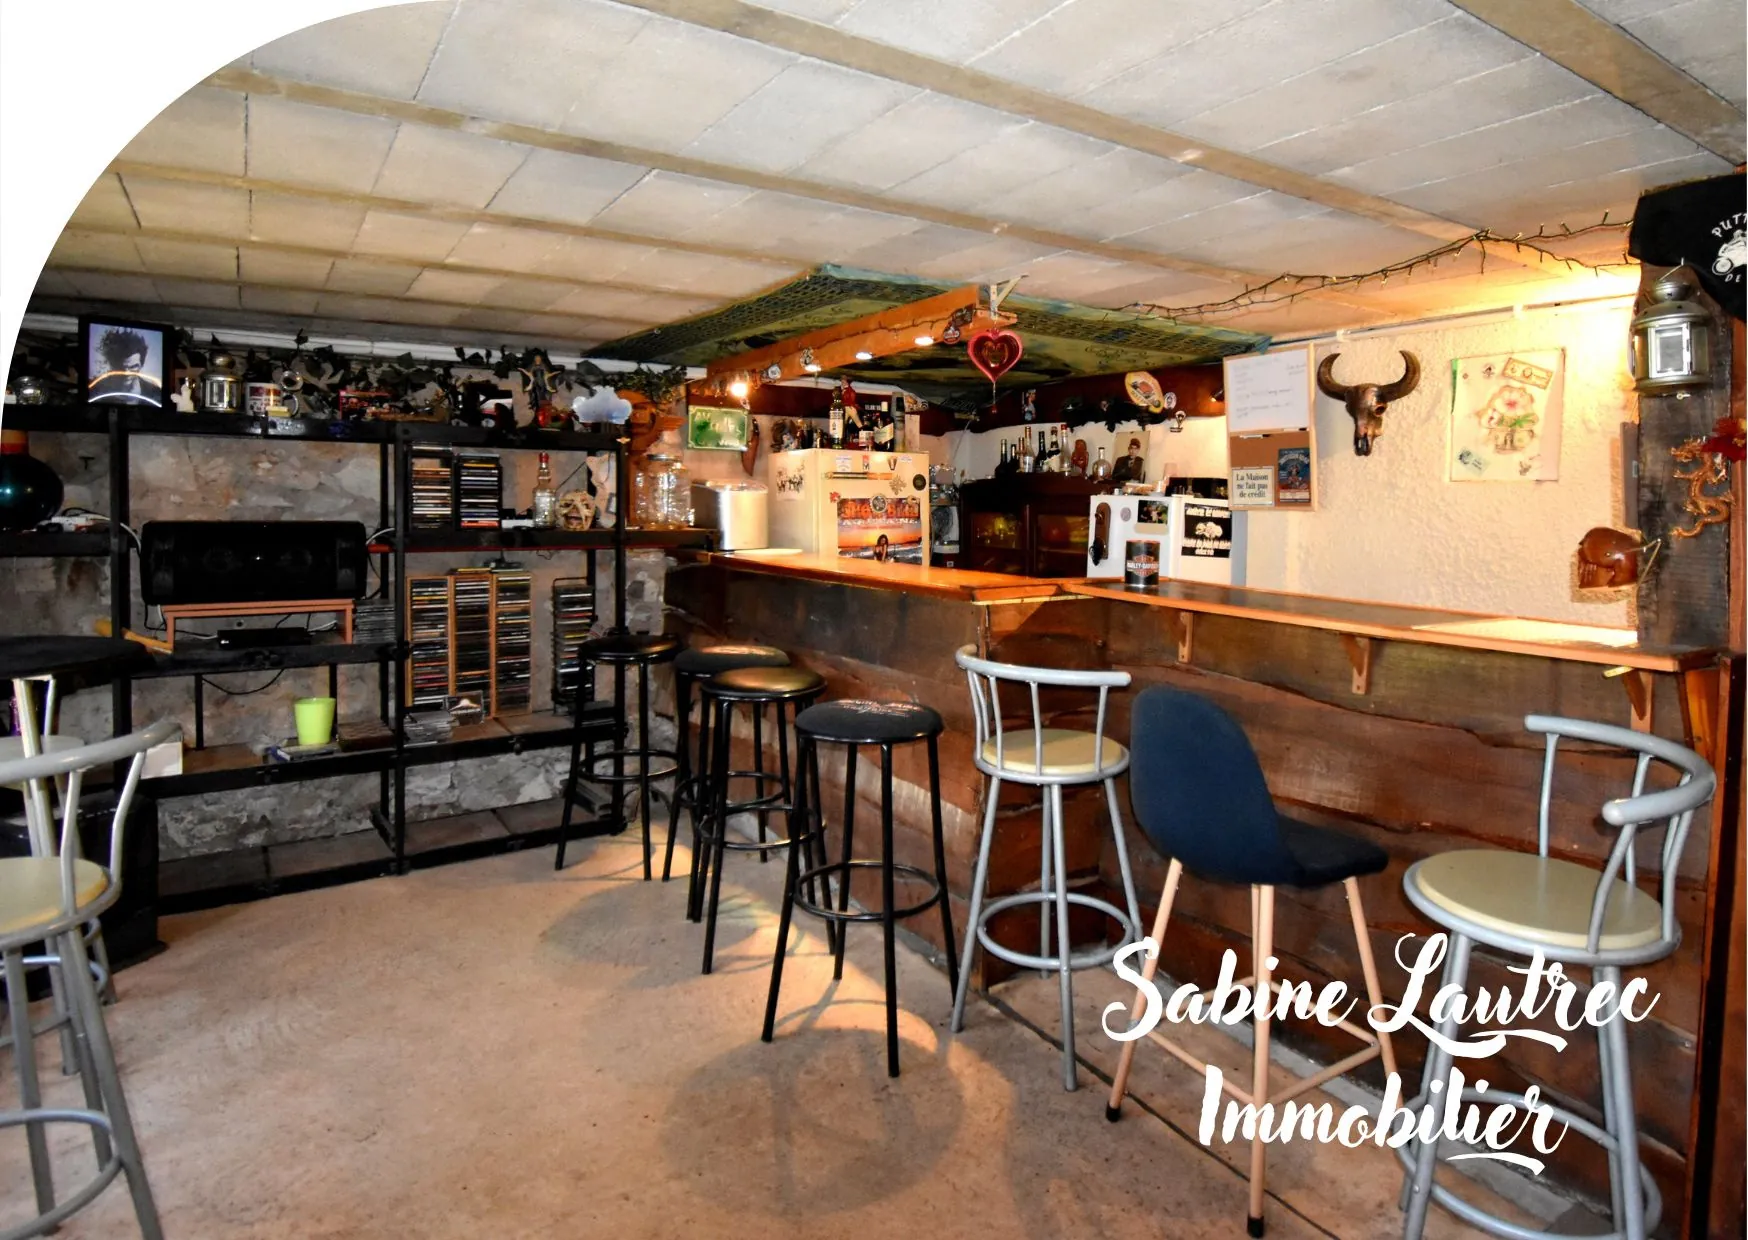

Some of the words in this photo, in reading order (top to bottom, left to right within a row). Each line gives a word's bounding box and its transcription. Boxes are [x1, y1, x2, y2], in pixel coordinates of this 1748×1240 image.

[1236, 473, 1245, 481] La
[1246, 473, 1269, 481] Maison
[1245, 482, 1256, 490] fait
[1257, 484, 1268, 492] pas
